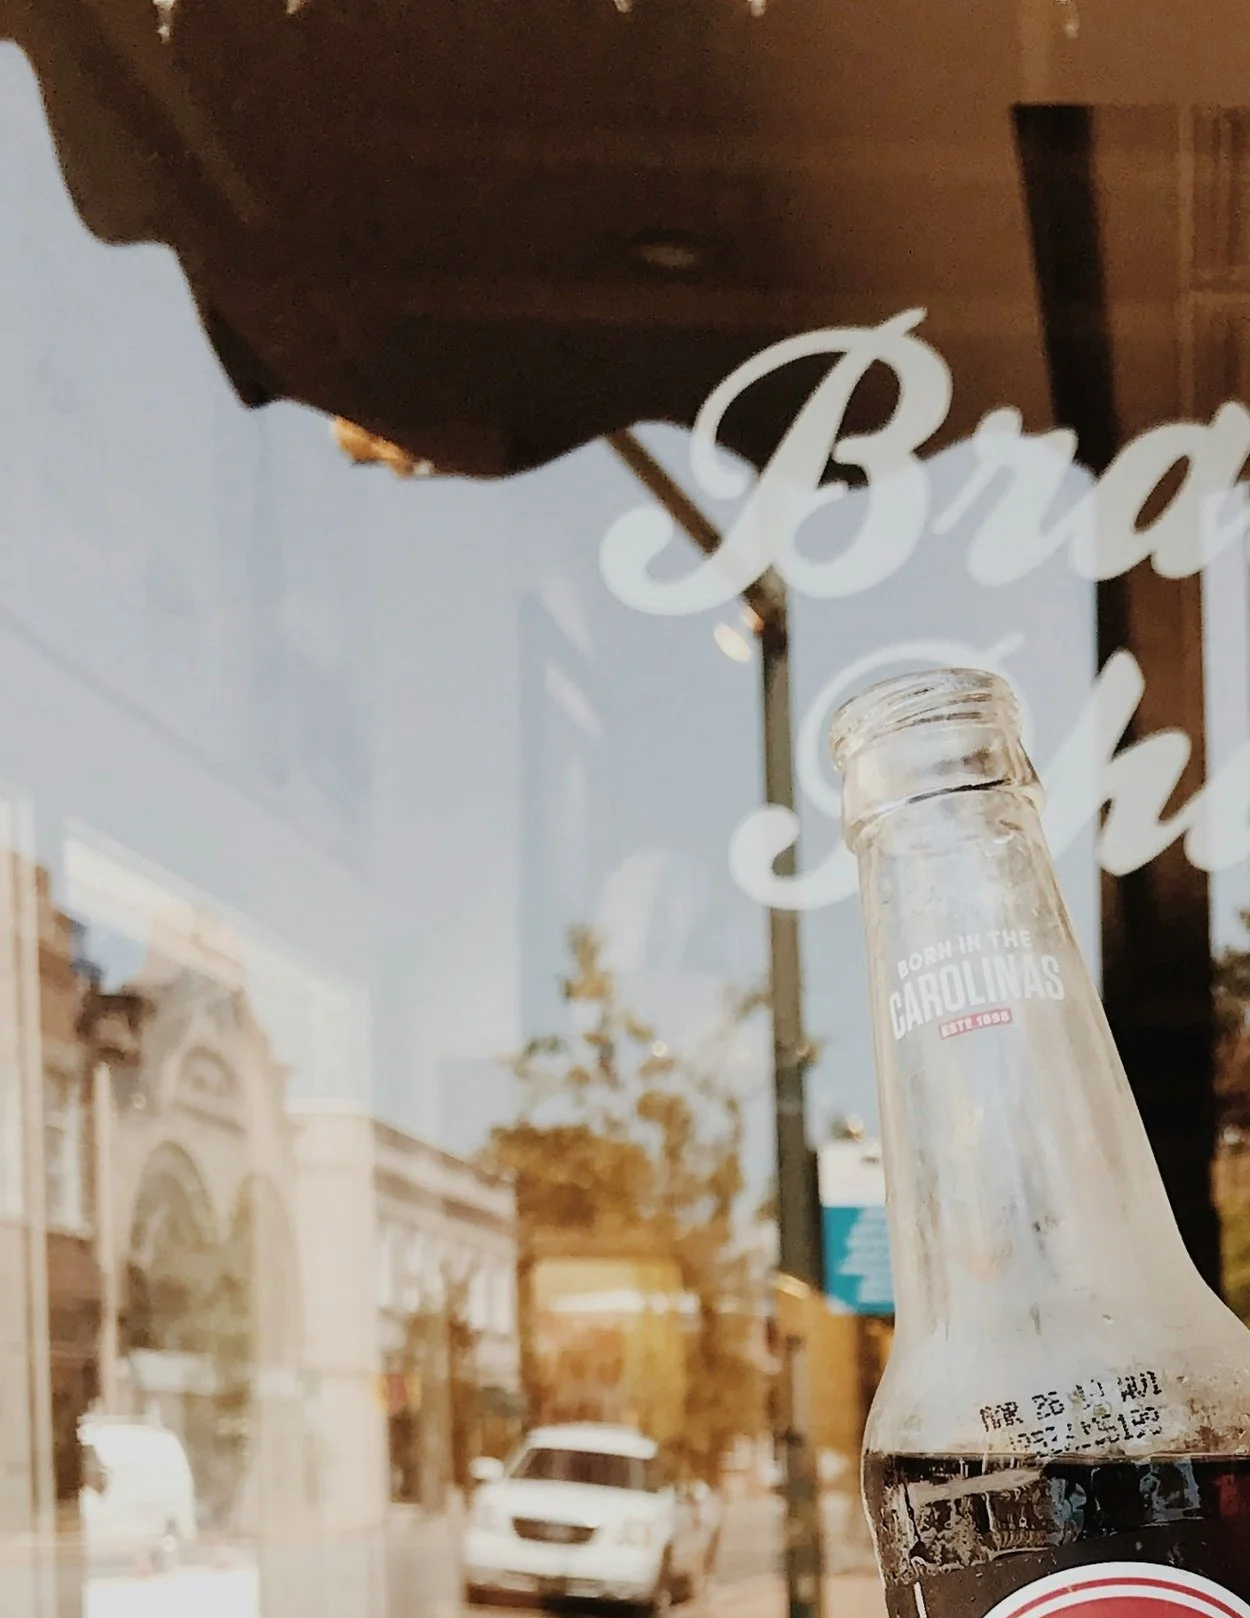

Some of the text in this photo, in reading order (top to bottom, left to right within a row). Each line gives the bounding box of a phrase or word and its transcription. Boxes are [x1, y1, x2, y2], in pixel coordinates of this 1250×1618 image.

[898, 928, 1033, 980] BORN IN THE
[889, 953, 1065, 1041] CAROLINAS
